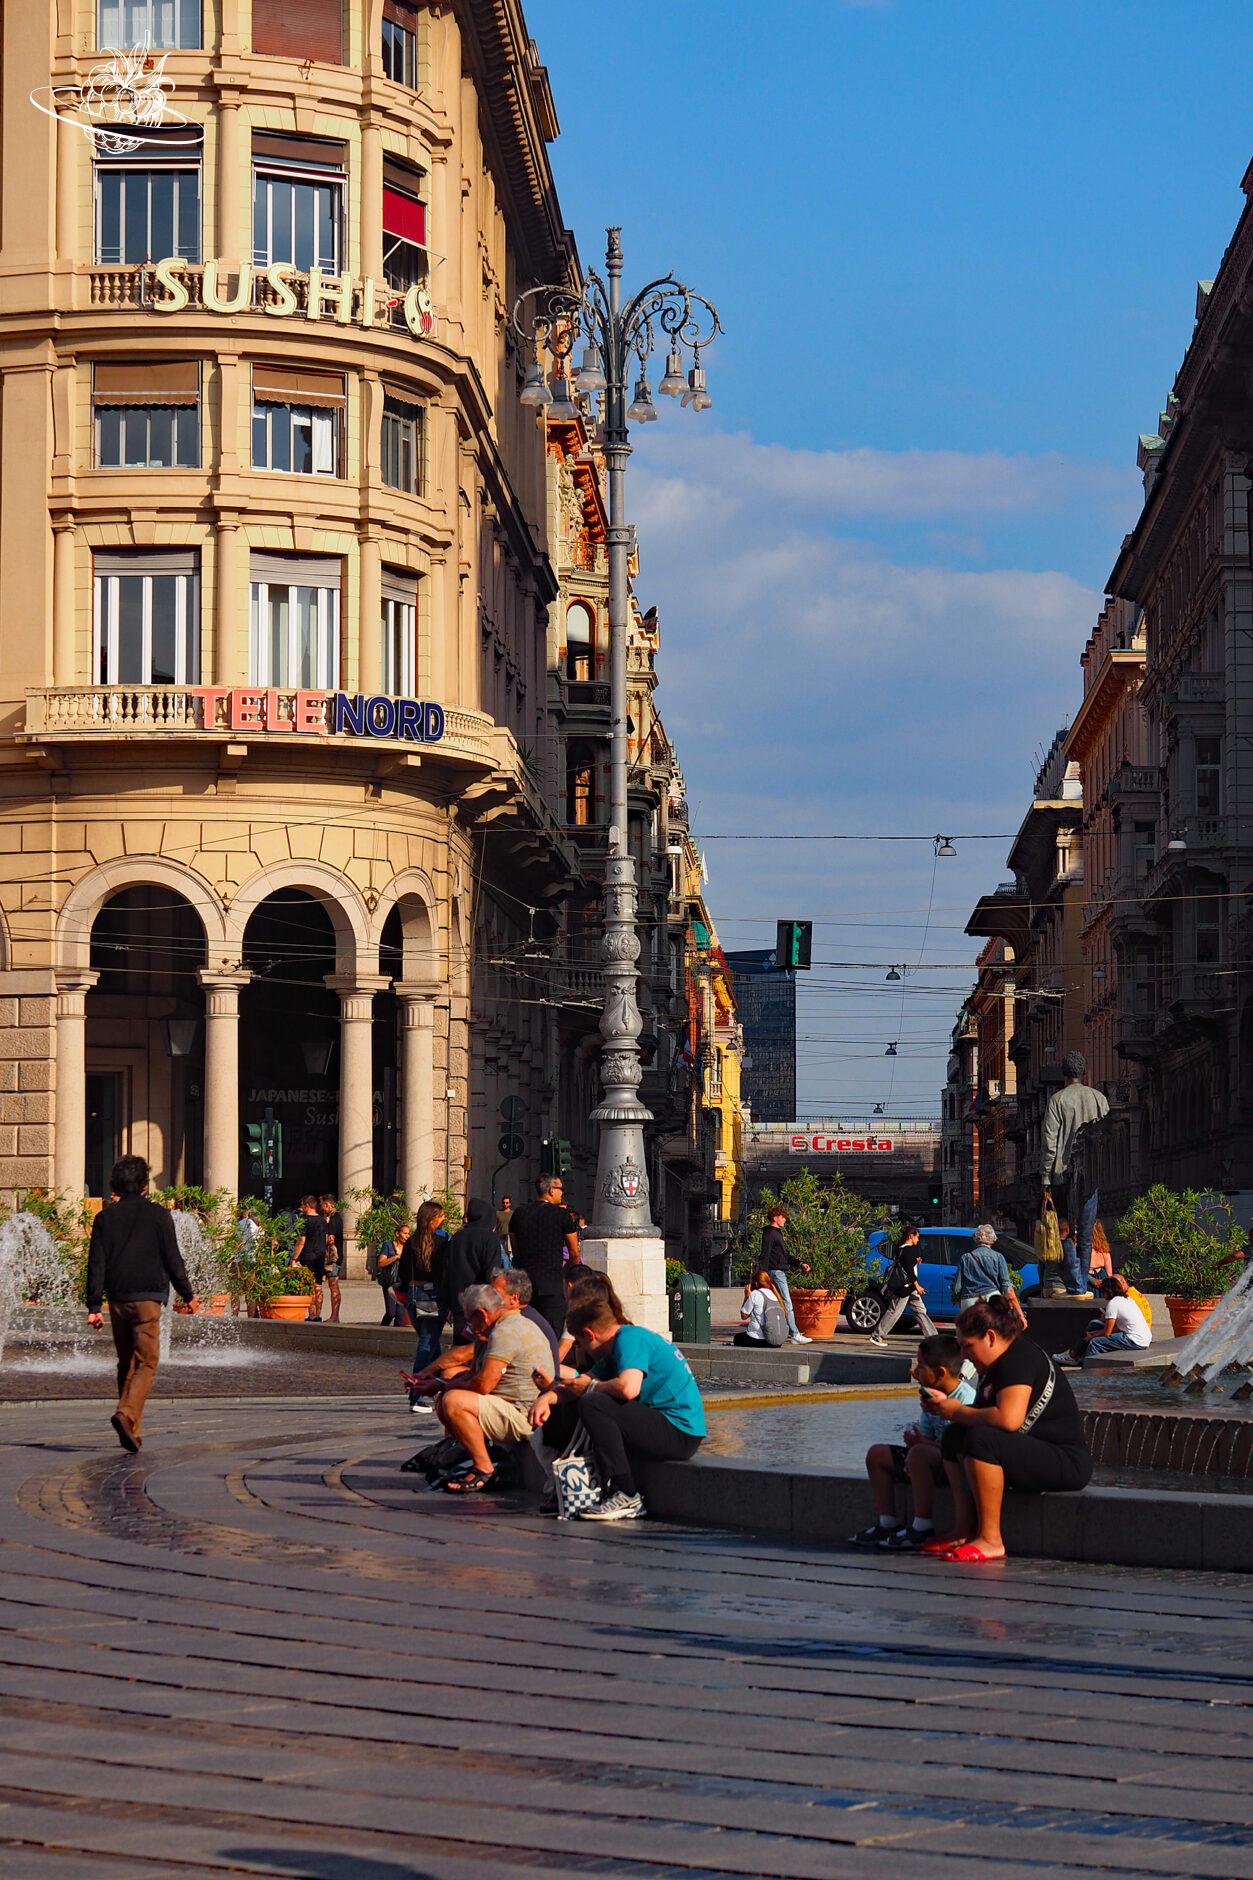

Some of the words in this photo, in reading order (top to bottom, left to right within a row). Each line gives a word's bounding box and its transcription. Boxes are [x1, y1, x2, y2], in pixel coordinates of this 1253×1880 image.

[153, 257, 374, 327] SUSHI
[191, 687, 326, 734] TELE
[334, 692, 445, 743] NORD
[812, 1135, 892, 1151] Cresta
[1030, 1402, 1044, 1418] YOU
